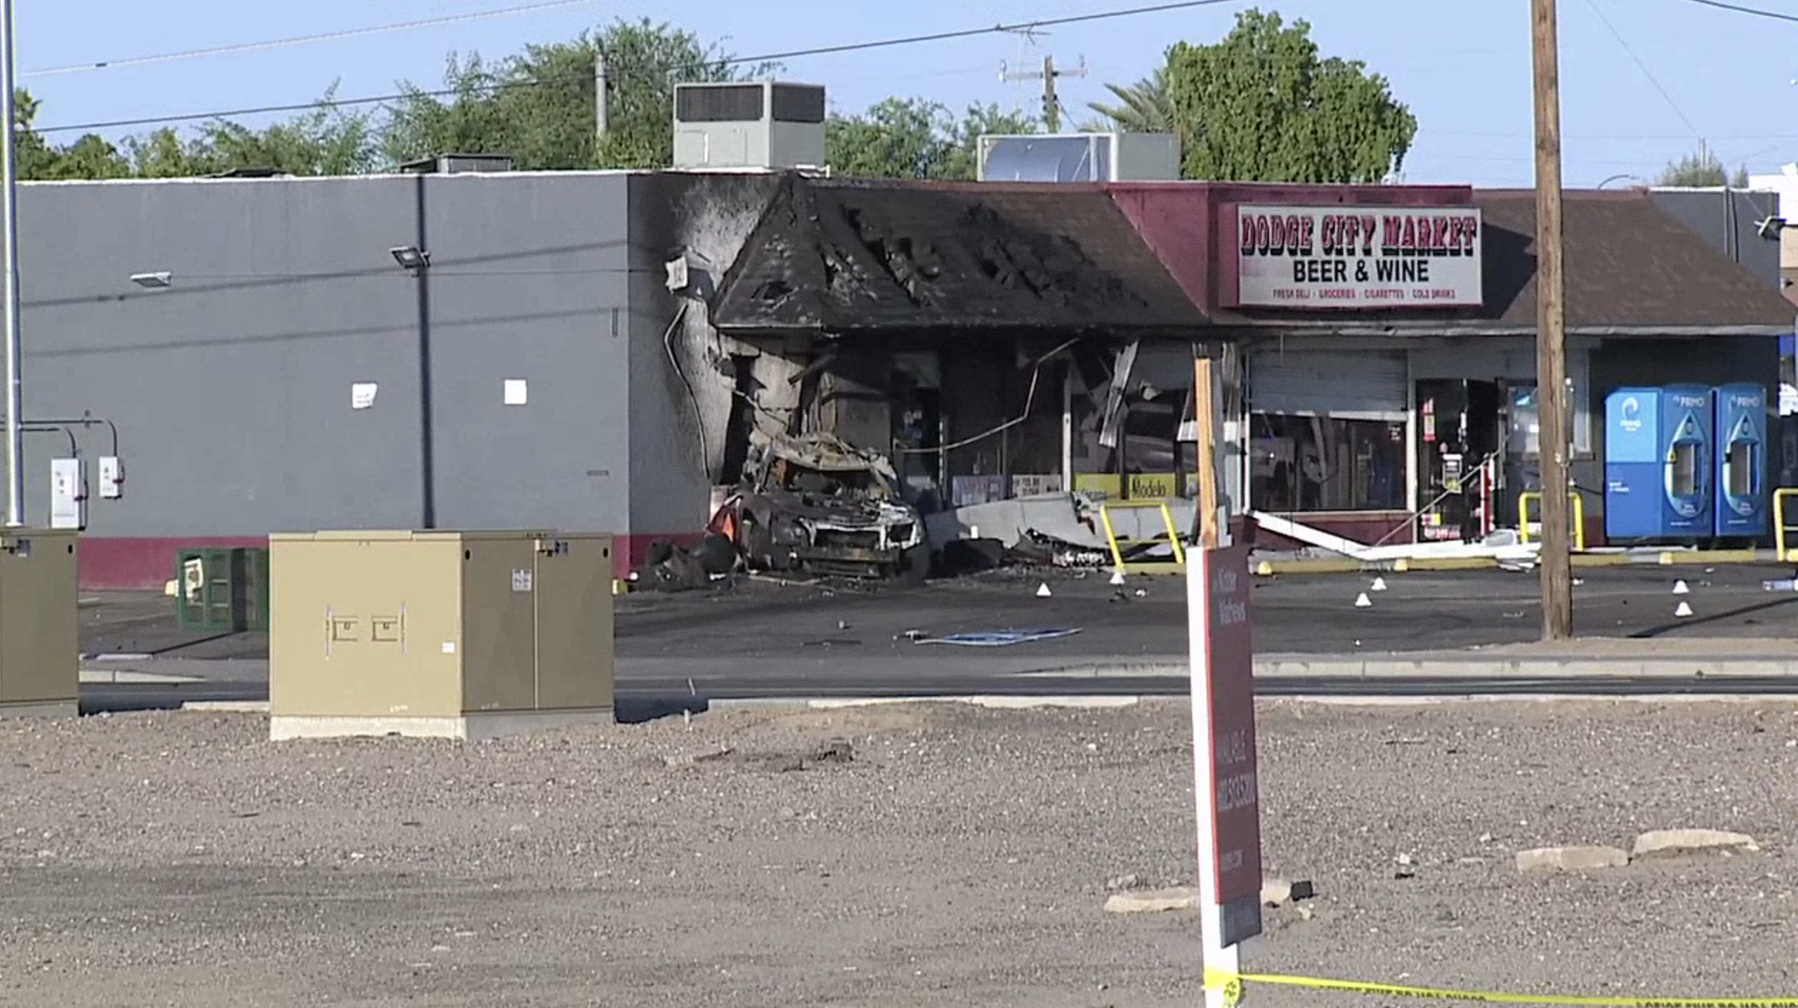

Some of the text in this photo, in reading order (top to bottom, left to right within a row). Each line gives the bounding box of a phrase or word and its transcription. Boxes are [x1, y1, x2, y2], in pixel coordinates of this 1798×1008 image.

[1241, 214, 1477, 256] DODGE CITY MARKET
[1293, 259, 1430, 282] BEER & WINE
[1273, 289, 1295, 299] FRESH
[1295, 289, 1310, 299] DELI
[1319, 289, 1356, 299] GROCERIES
[1364, 289, 1405, 299] CIGARETTES
[1412, 289, 1430, 299] COLD
[1680, 396, 1705, 408] PRIMO
[1737, 396, 1760, 408] PRIMO
[1131, 477, 1167, 498] Modelo
